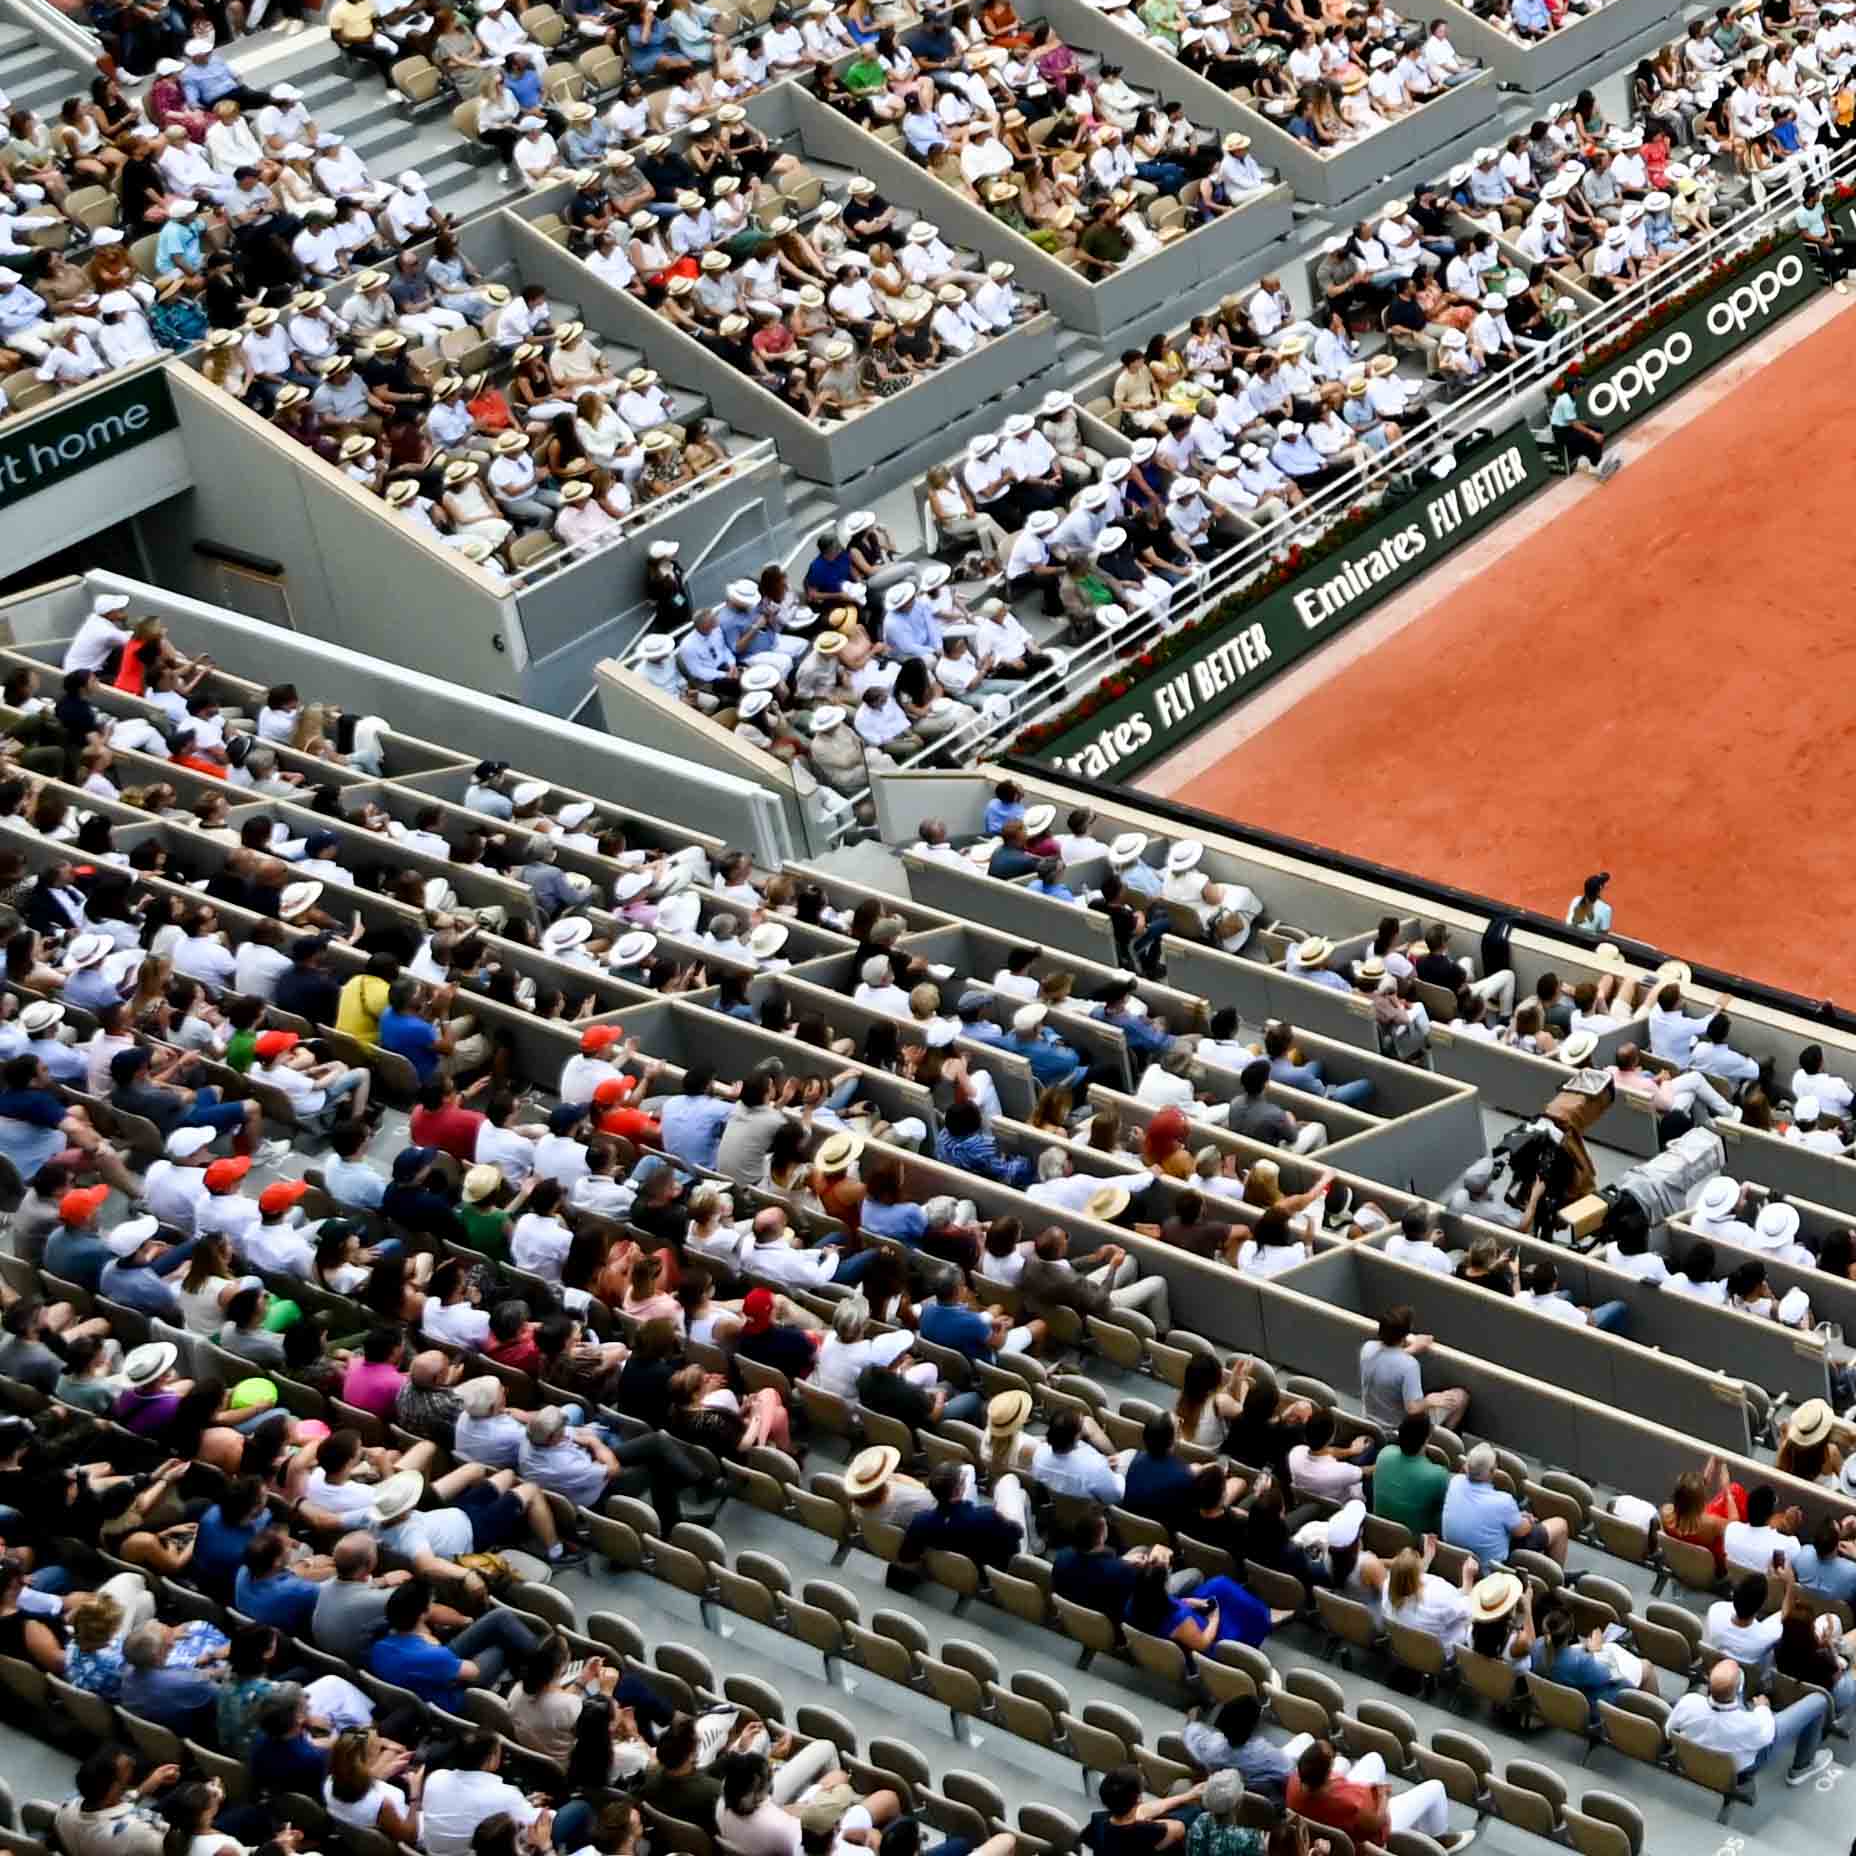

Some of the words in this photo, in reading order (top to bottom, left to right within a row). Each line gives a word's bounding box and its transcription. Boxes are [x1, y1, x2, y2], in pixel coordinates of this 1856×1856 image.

[1707, 255, 1804, 336] oppo
[1588, 331, 1693, 419] oppo
[29, 404, 150, 476] home
[1293, 523, 1426, 631] Emirates
[1426, 489, 1465, 539] FLY
[1460, 446, 1529, 511] BETTER
[1053, 712, 1152, 779] rates
[1154, 667, 1195, 728] FLY
[1199, 623, 1273, 705] BETTER
